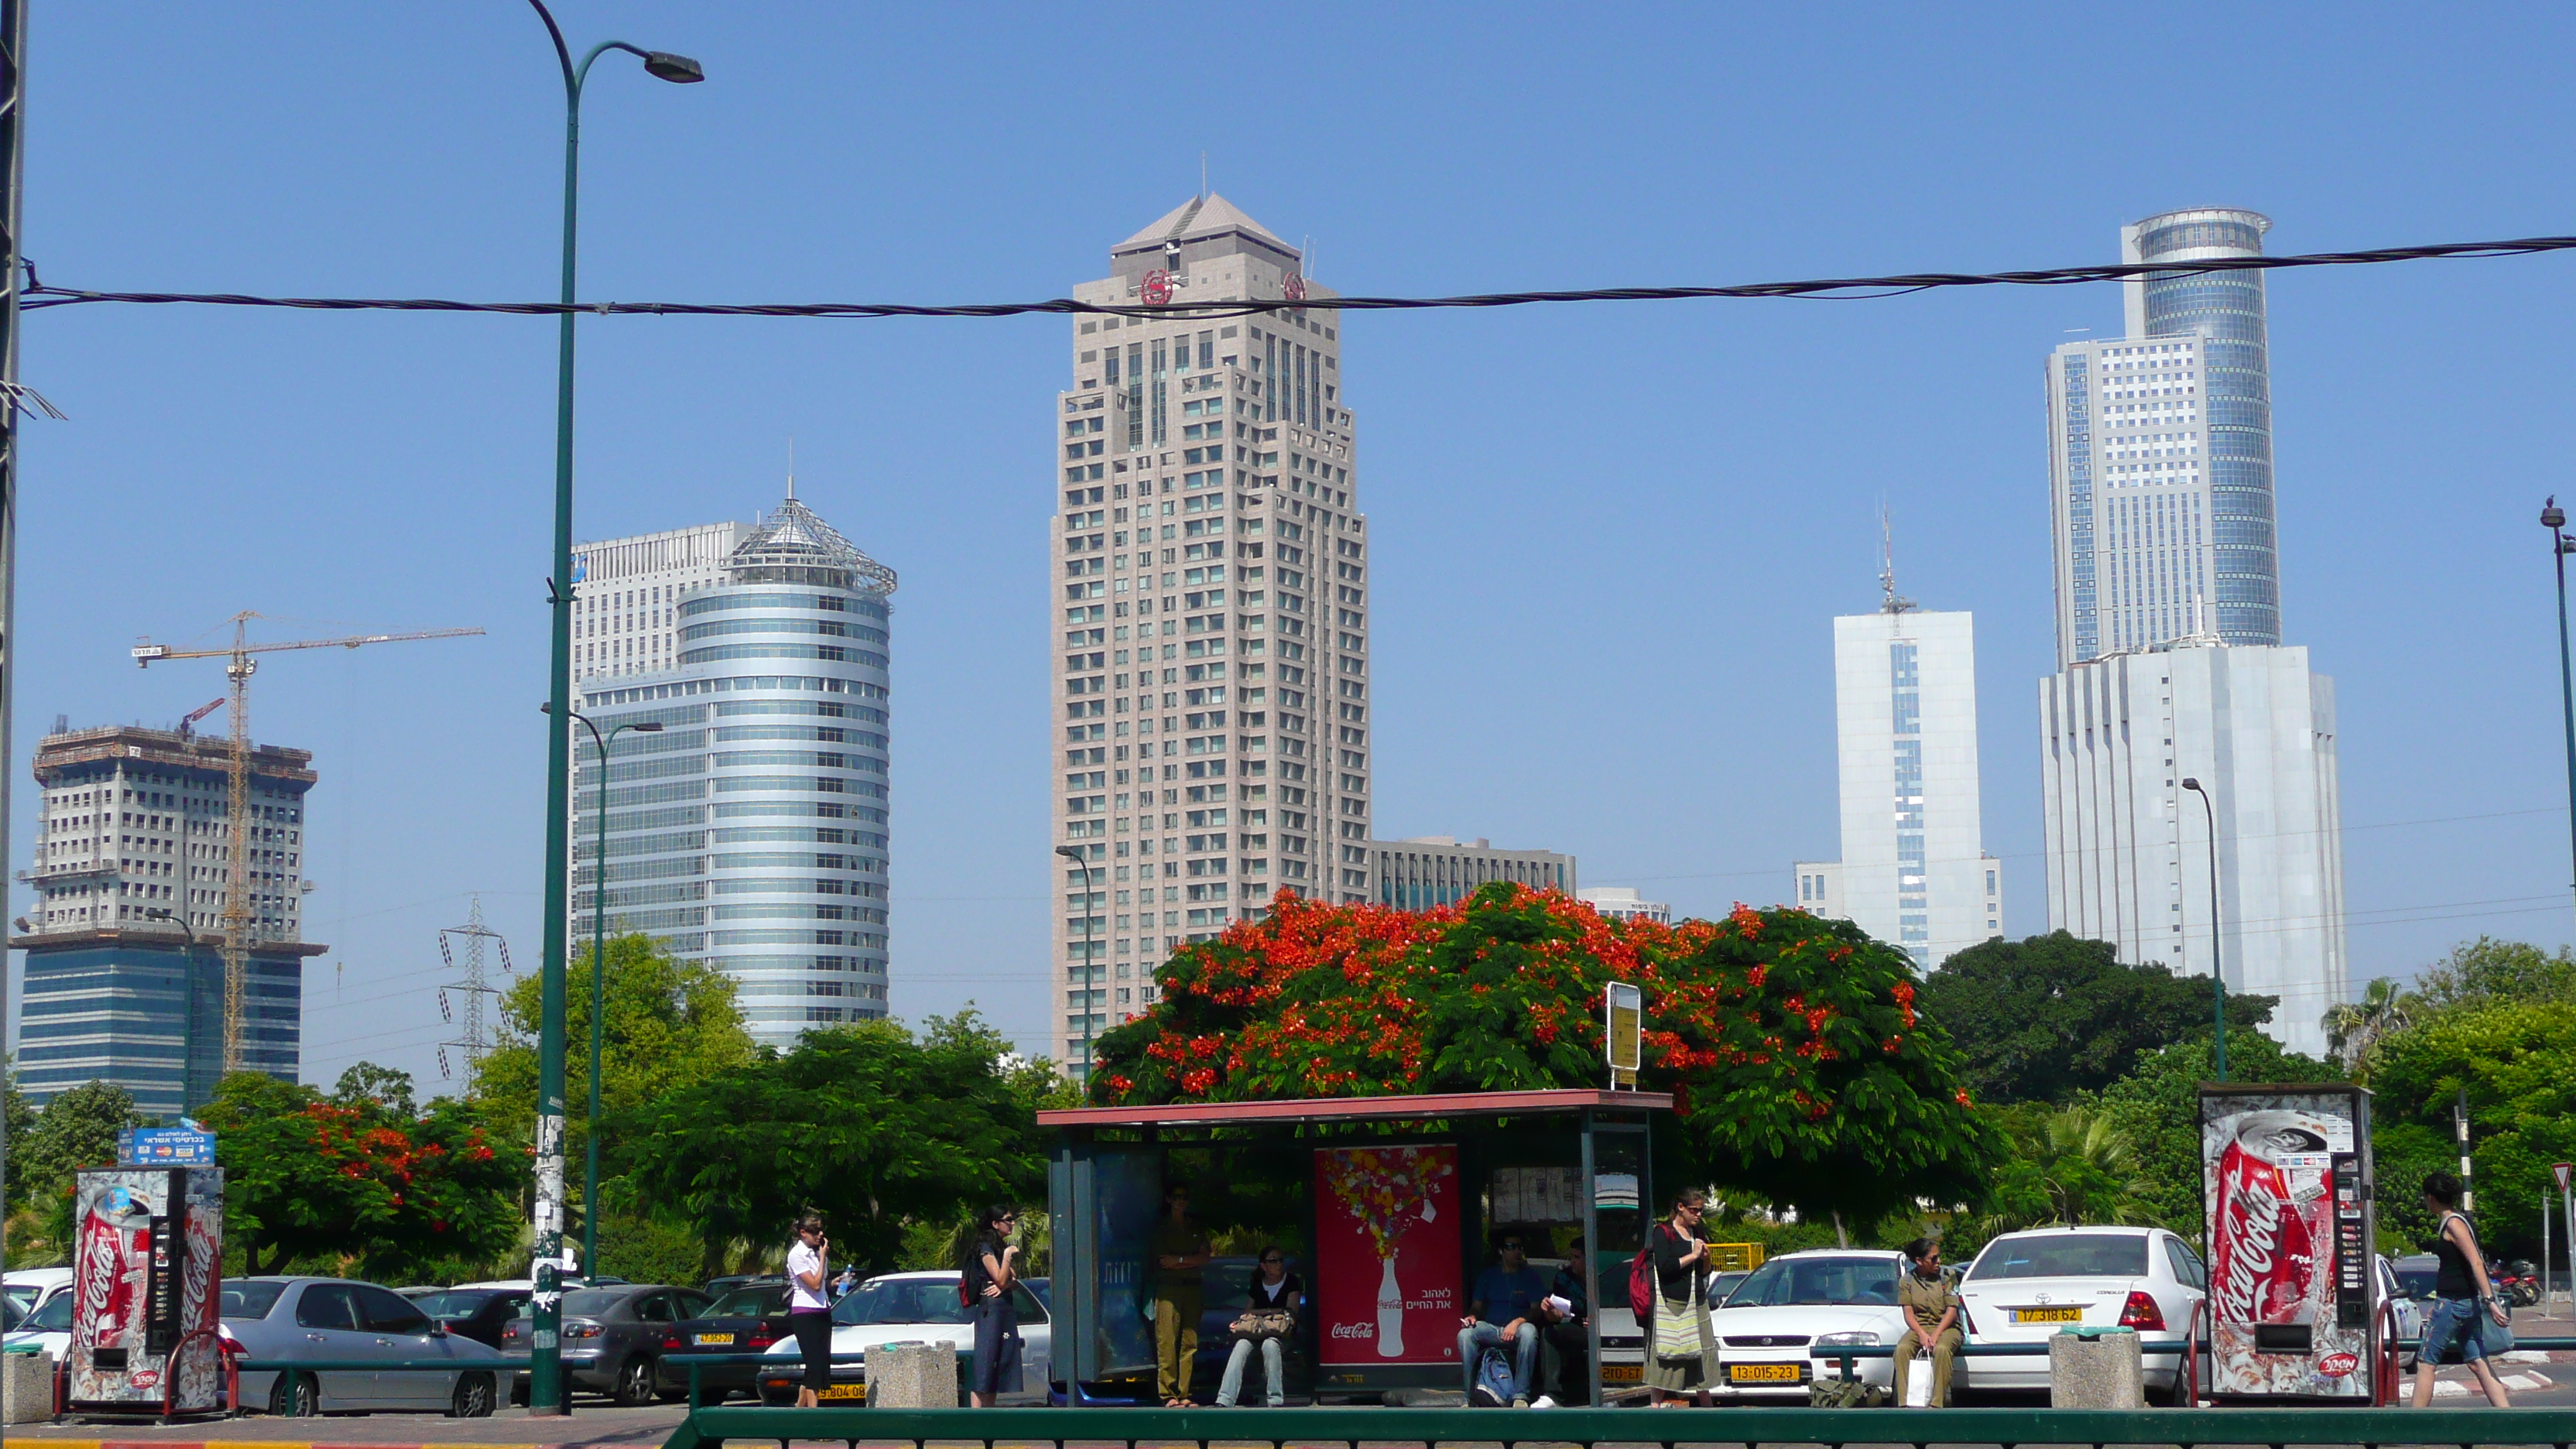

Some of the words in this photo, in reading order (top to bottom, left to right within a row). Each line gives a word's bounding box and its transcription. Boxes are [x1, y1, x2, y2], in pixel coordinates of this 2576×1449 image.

[1421, 1287, 1451, 1298] לאהוב
[1406, 1301, 1433, 1310] החיים
[1436, 1300, 1451, 1309] את
[1331, 1321, 1375, 1338] Coca-Cola
